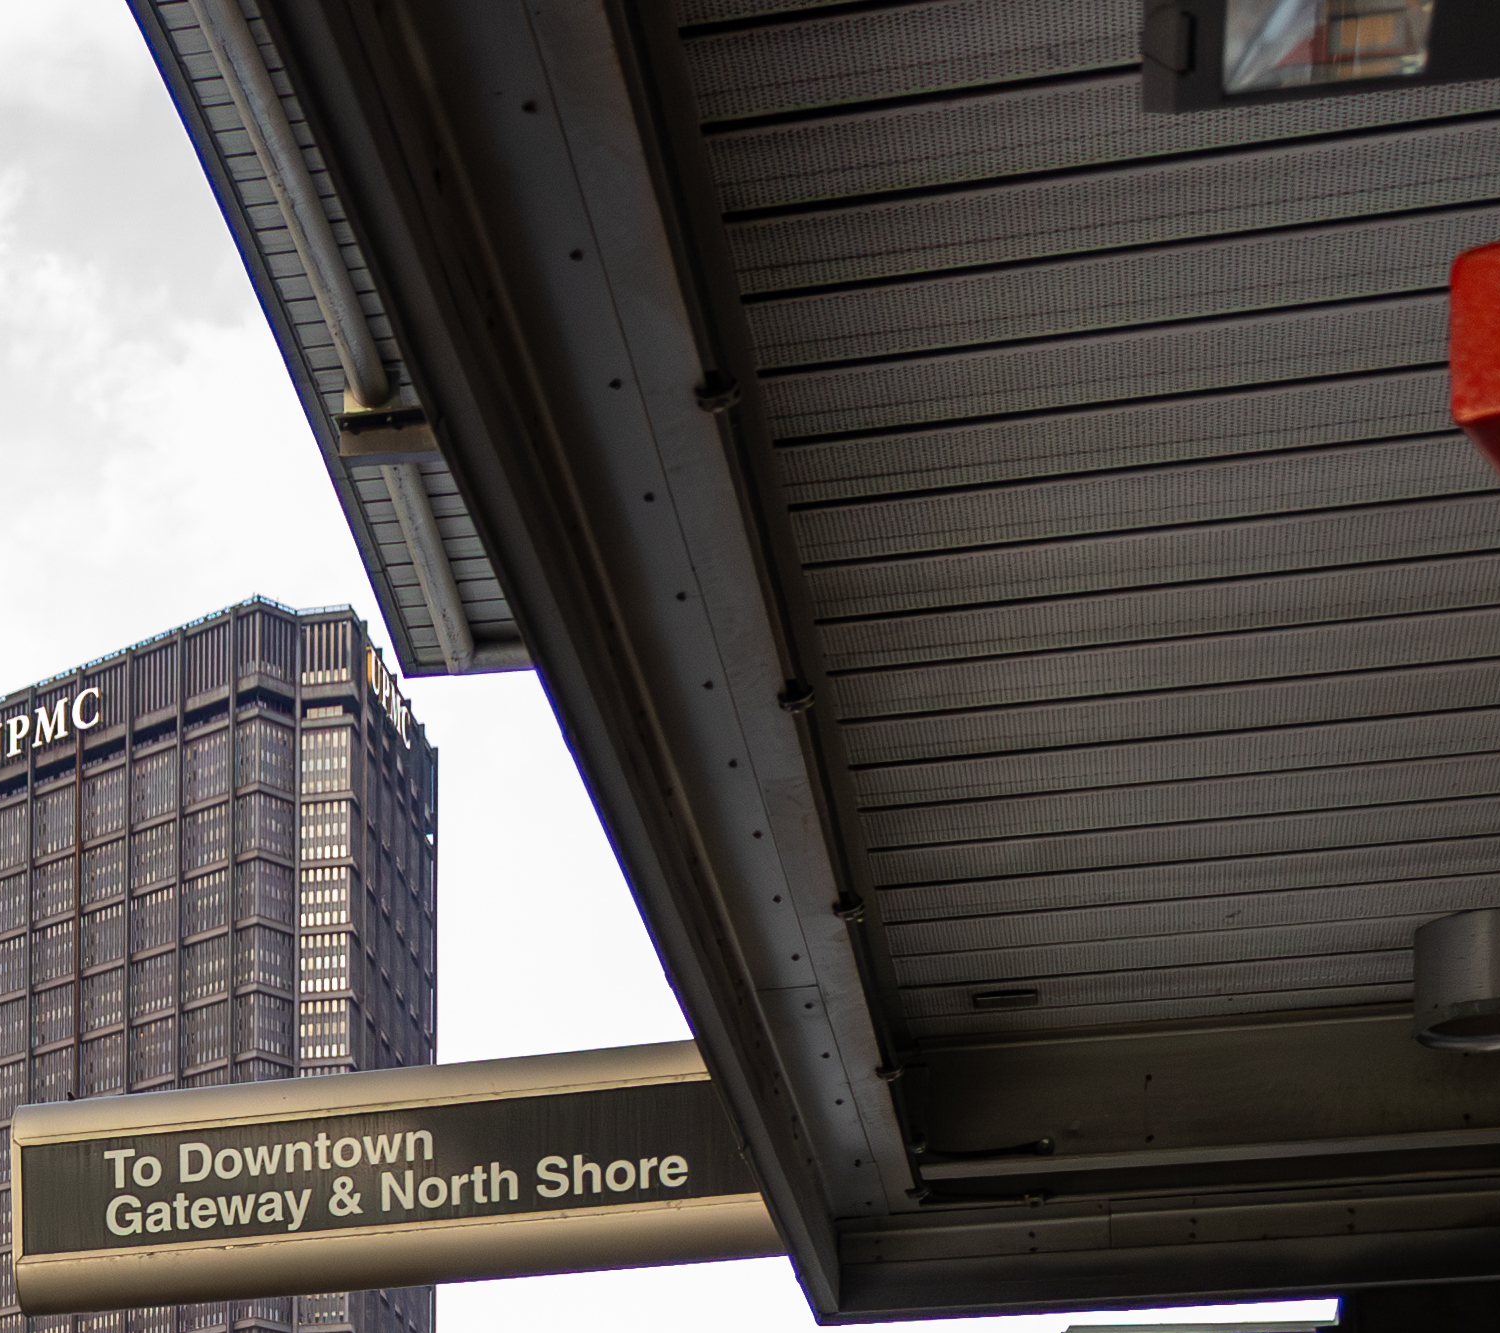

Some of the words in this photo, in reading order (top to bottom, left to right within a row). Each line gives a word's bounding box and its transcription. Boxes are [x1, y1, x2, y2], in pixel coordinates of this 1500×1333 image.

[366, 644, 411, 750] UPMC
[103, 1146, 162, 1189] To
[179, 1124, 434, 1185] Downtown
[105, 1187, 312, 1237] Gateway
[327, 1174, 363, 1217] &
[380, 1161, 519, 1213] North
[536, 1153, 689, 1199] Shore
